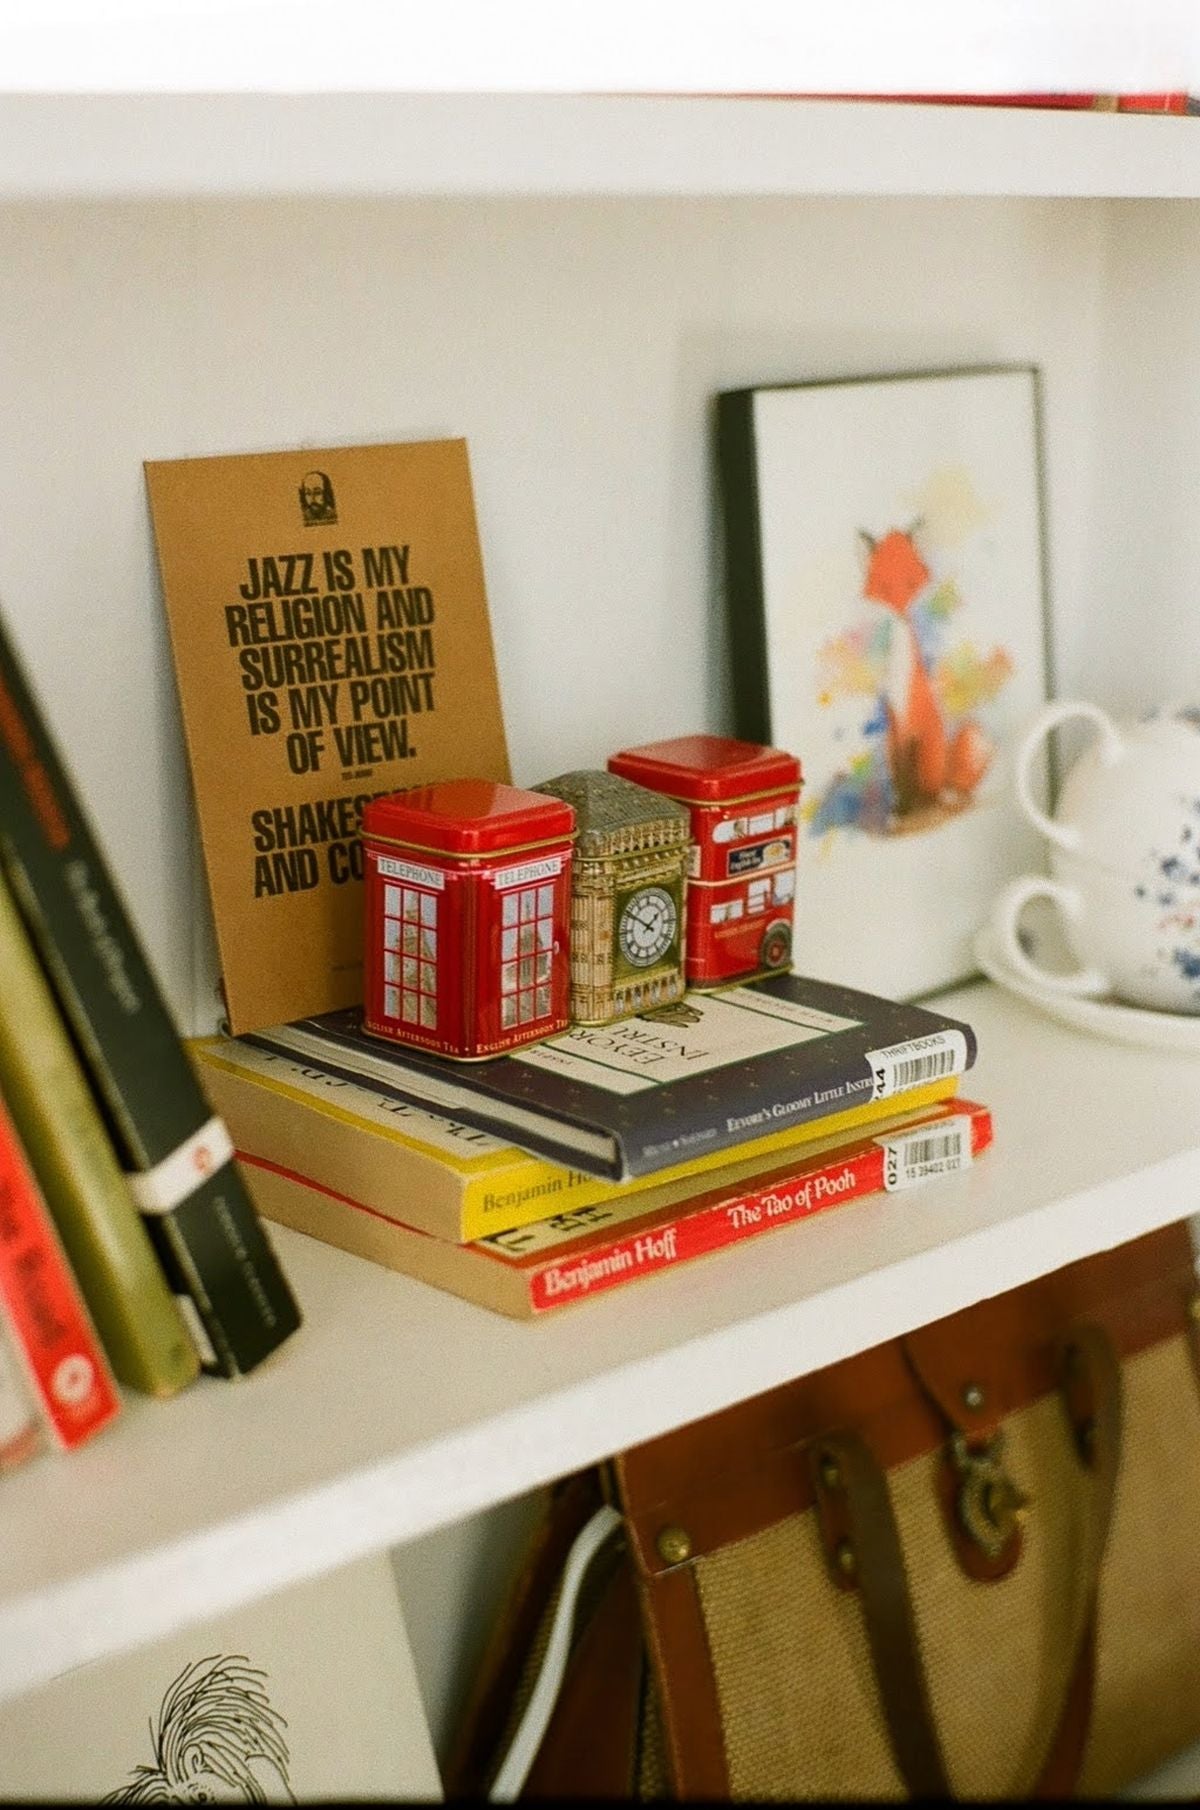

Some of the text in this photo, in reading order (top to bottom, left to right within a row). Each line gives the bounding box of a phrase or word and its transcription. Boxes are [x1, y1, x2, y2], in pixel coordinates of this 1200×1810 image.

[240, 545, 409, 600] JAZZ IS MY
[225, 587, 434, 647] RELIGION AND
[239, 629, 435, 691] SURREALISM
[246, 672, 435, 735] IS MY POINT
[286, 719, 417, 775] OF VIEW.
[255, 848, 319, 898] AND
[380, 859, 442, 887] TELEPHONE
[498, 859, 560, 887] TELEPHONE
[475, 1037, 511, 1054] ENGLISH
[513, 1023, 554, 1044] AFTERNOON
[881, 1035, 946, 1059] THRIFTBOOKS
[772, 1095, 813, 1117] GLOOMY
[813, 1086, 845, 1105] LITTLE
[887, 1147, 898, 1185] 027
[484, 1176, 562, 1213] Benjamin
[727, 1168, 856, 1229] The Tao of Pooh
[543, 1248, 633, 1297] Benjamin
[634, 1227, 677, 1263] Hoff
